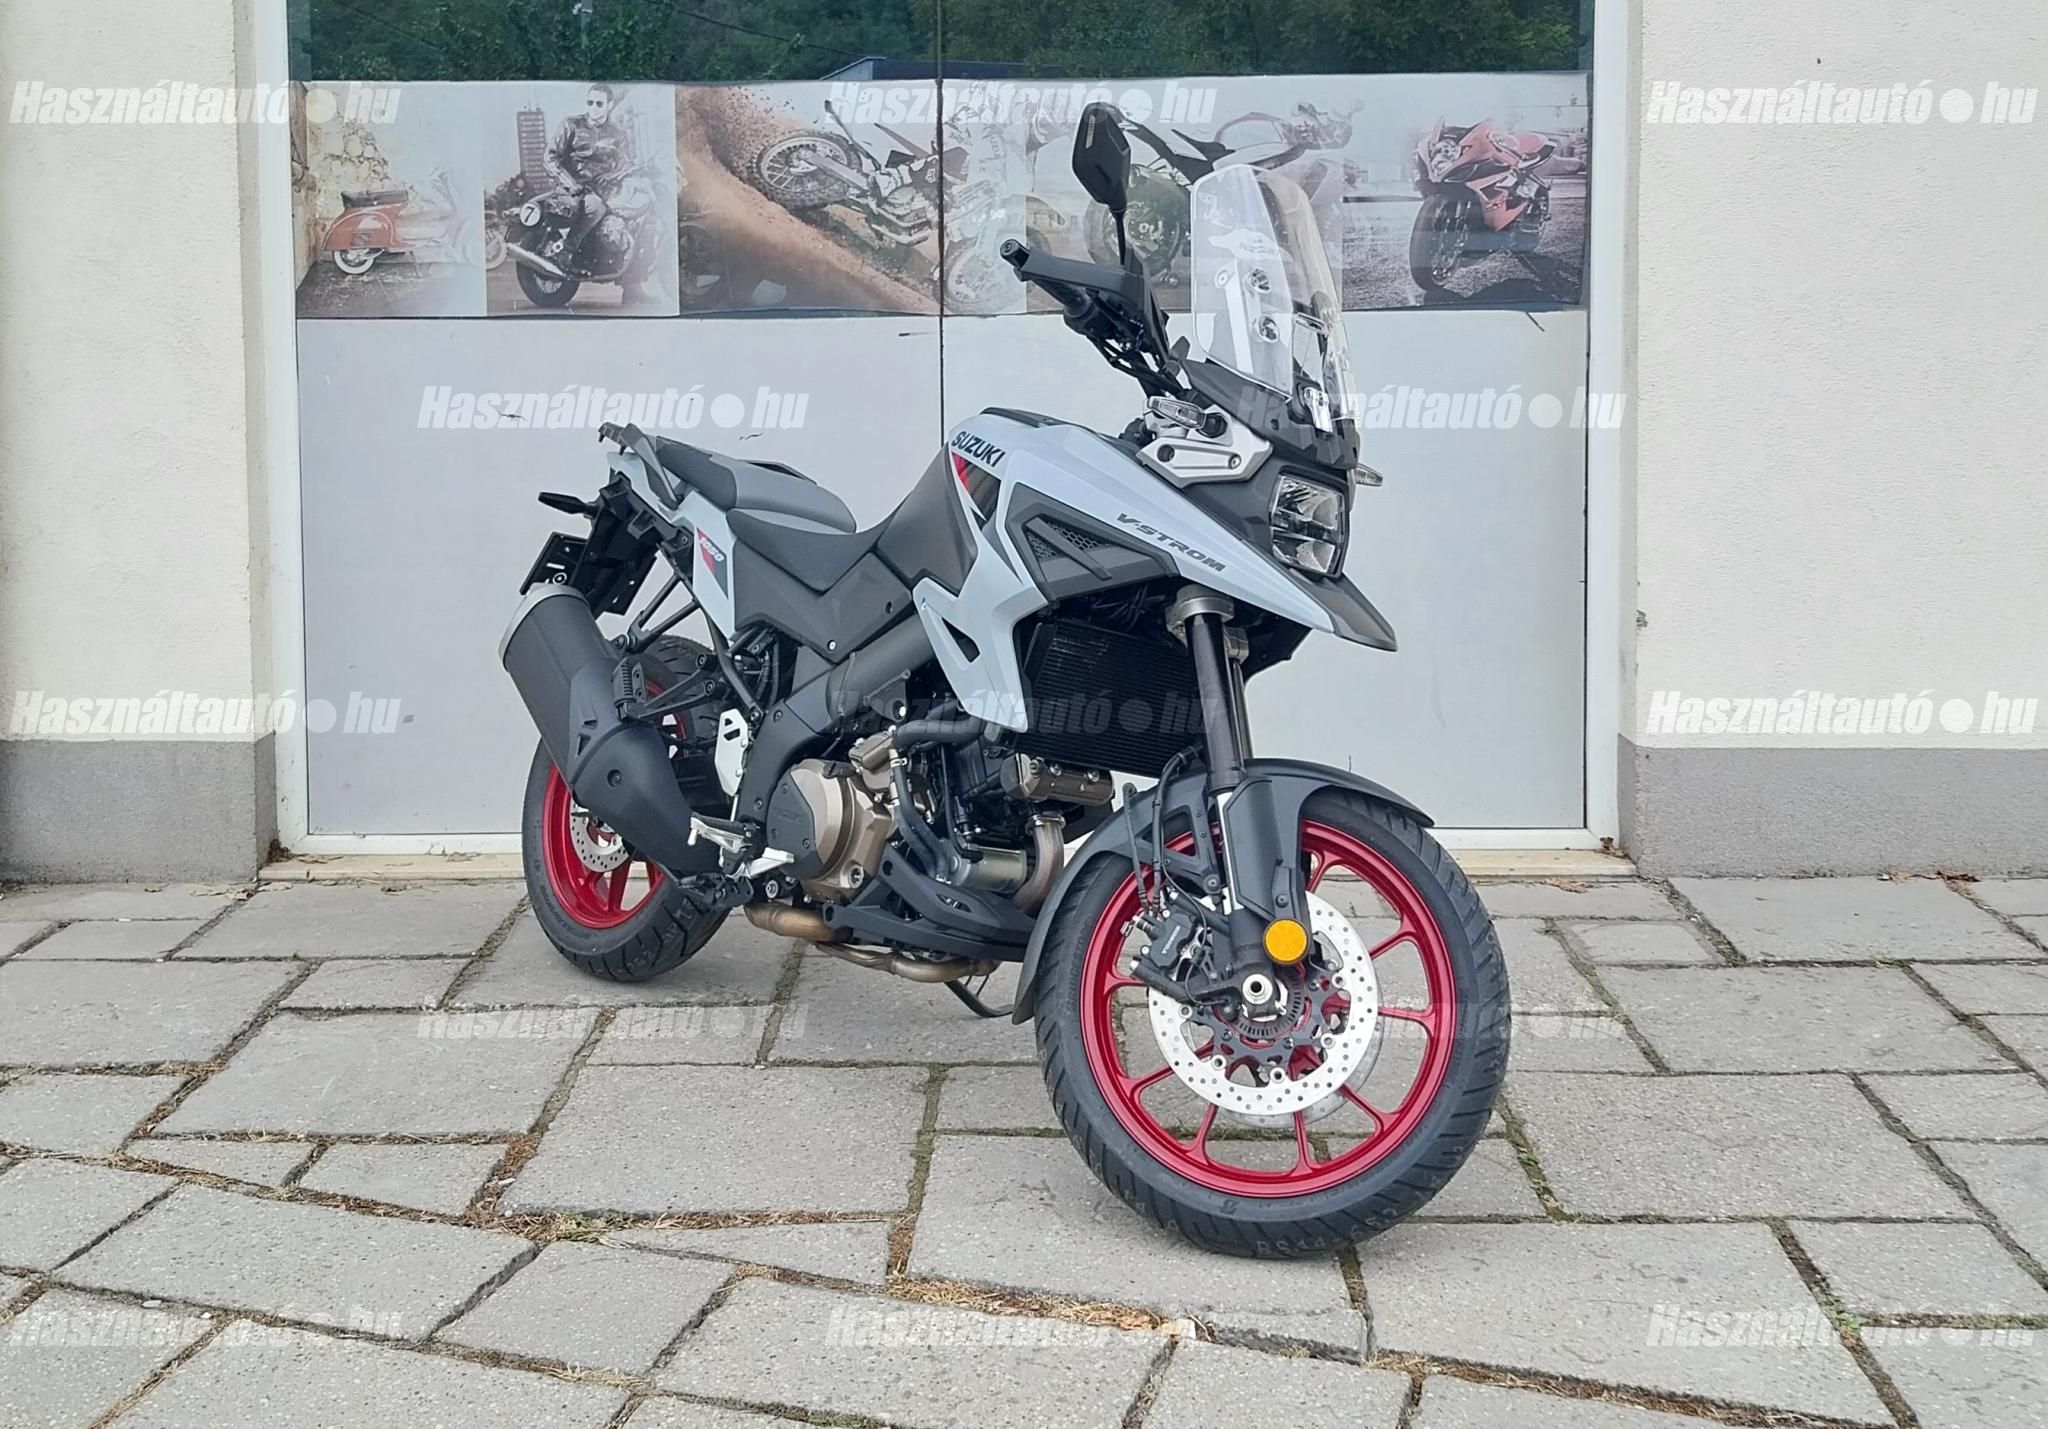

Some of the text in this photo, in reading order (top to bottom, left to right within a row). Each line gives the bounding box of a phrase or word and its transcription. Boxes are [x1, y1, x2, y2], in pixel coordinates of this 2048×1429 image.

[524, 206, 536, 223] 7
[951, 430, 1006, 468] SUZUKI
[1117, 513, 1226, 572] V-STROM
